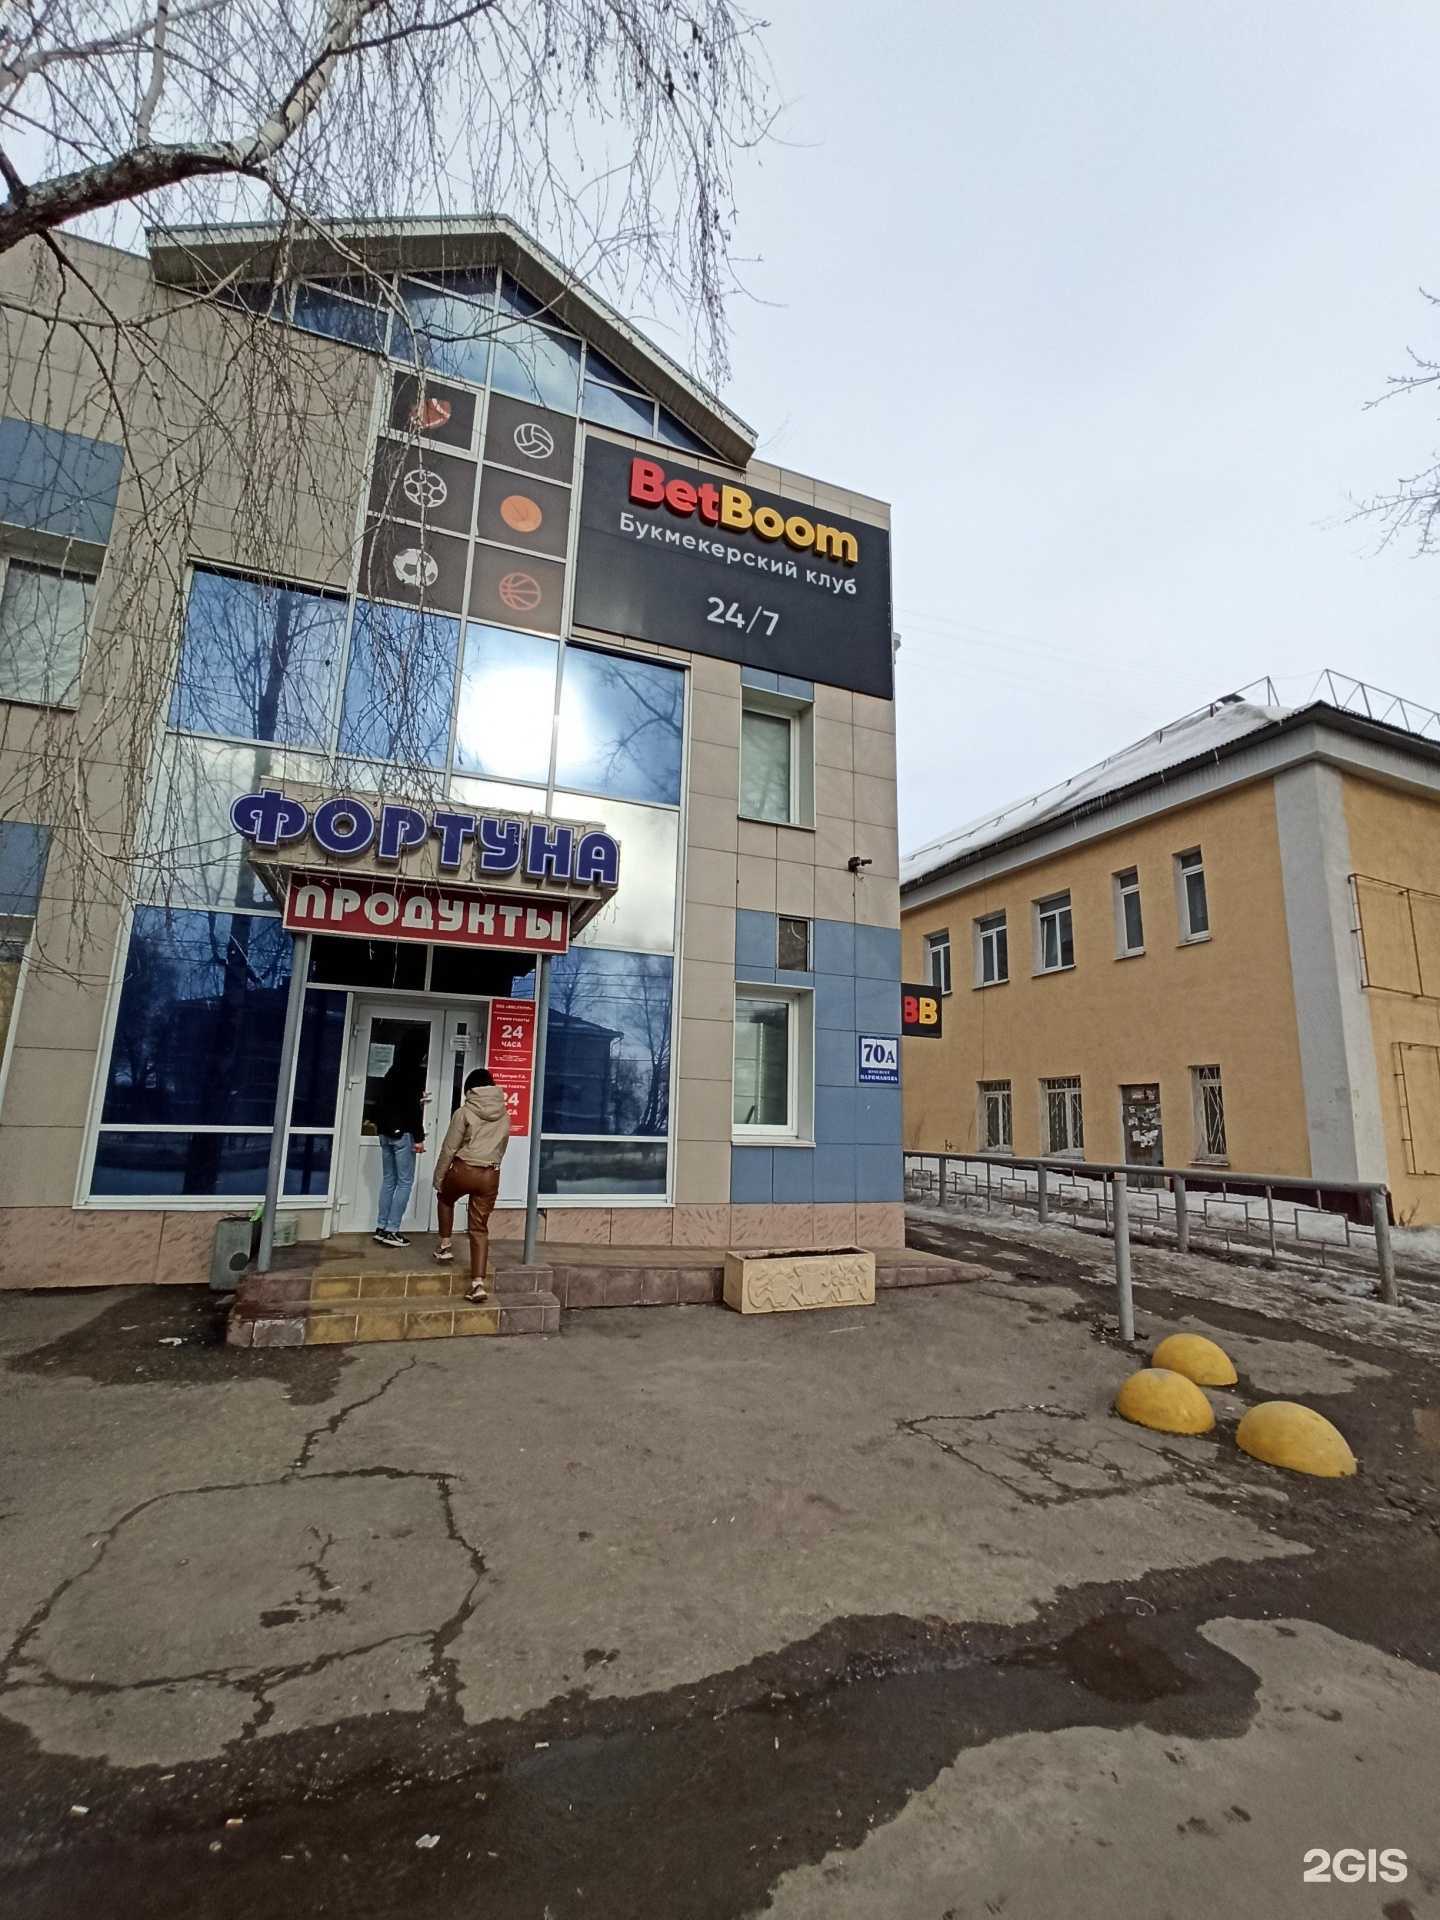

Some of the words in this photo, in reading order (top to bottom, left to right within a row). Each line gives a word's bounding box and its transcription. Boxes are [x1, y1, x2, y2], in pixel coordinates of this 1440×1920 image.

[629, 457, 858, 566] BetBoom
[619, 511, 797, 579] Букмекерский
[806, 569, 857, 595] клуб
[706, 596, 779, 636] 24/7
[230, 788, 621, 887] ФОРТУНА
[294, 885, 563, 942] ПРОДУКТЫ
[501, 1024, 524, 1039] 24
